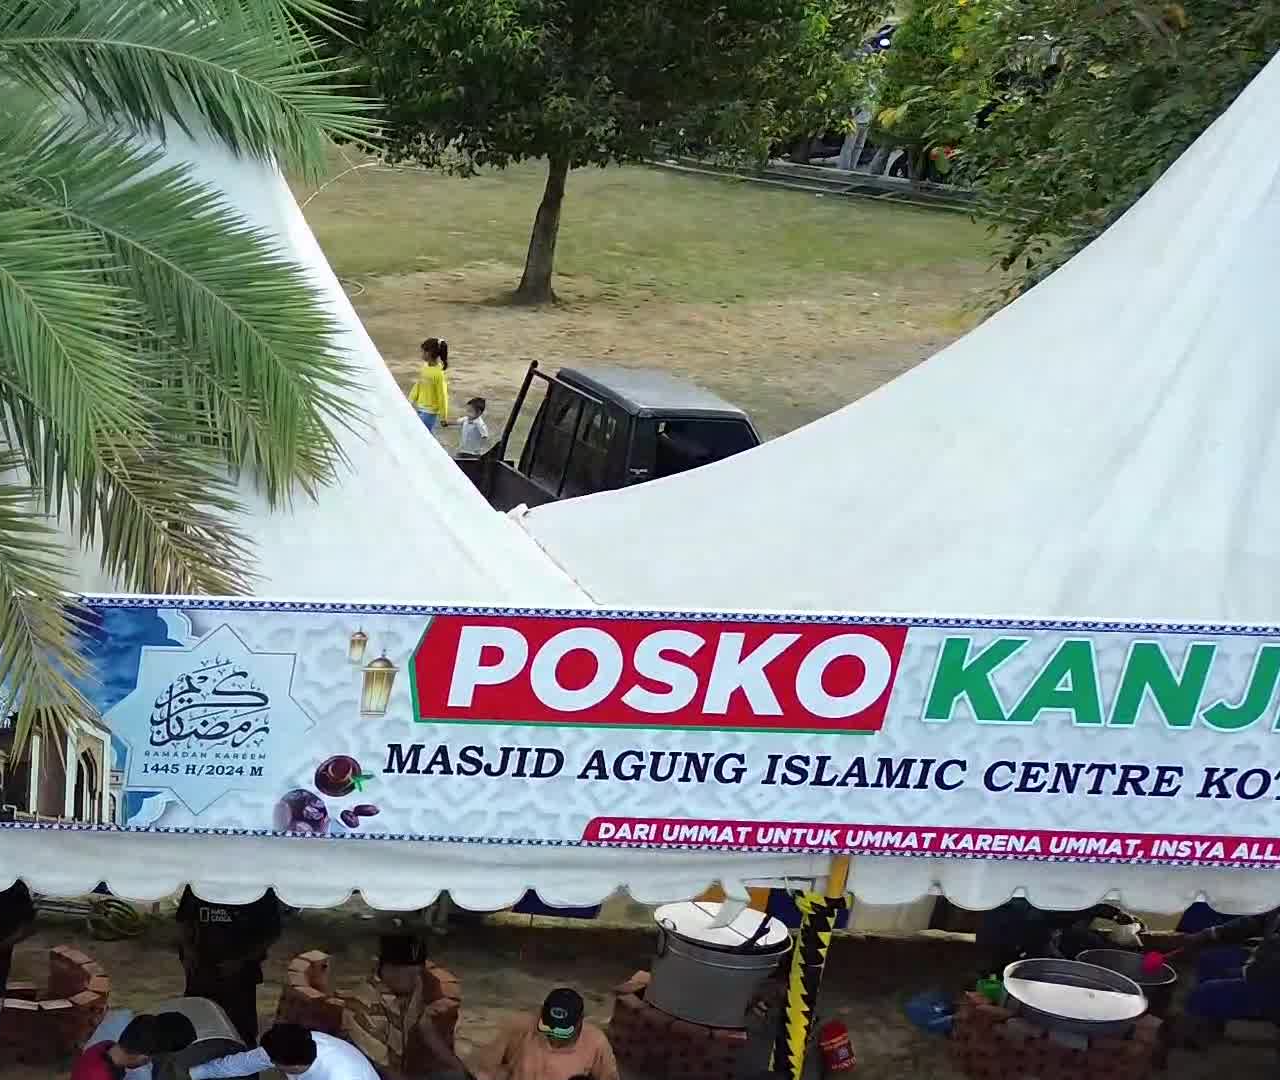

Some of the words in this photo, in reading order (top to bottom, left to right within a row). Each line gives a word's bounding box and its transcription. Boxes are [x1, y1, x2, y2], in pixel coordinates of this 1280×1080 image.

[447, 626, 892, 719] POSKO
[922, 636, 1280, 732] KANJ
[142, 763, 180, 774] 1445
[184, 764, 245, 776] H/2024
[249, 766, 264, 776] M
[144, 751, 207, 759] RAMADAN
[215, 752, 266, 760] KAREEM
[383, 743, 565, 779] MASJID
[576, 749, 747, 784] AGUNG
[761, 754, 967, 790] ISLAMIC
[983, 760, 1184, 797] CENTRE
[598, 822, 656, 841] DARI
[662, 824, 752, 844] UMMAT
[756, 828, 840, 846] UNTUK
[845, 829, 937, 848] UMMAT
[939, 832, 1041, 852] KARENA
[1049, 836, 1145, 857] UMMAT,
[1151, 840, 1225, 858] INSYA
[1231, 843, 1280, 861] ALL
